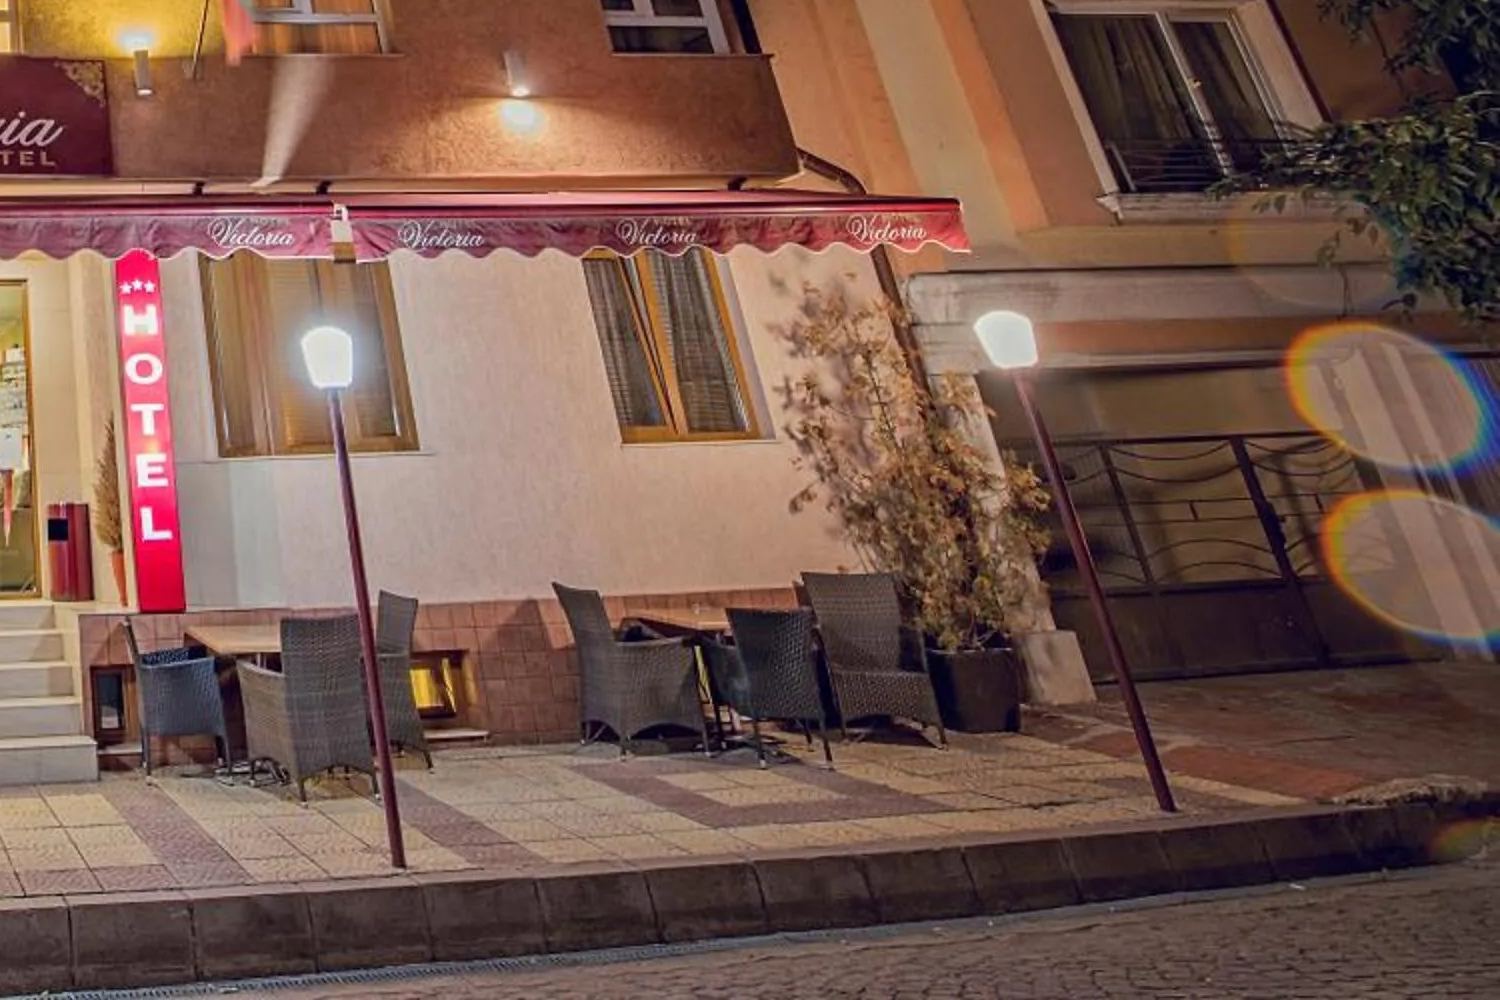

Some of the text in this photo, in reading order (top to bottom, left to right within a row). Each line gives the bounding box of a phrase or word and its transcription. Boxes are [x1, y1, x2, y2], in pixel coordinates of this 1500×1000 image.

[206, 216, 294, 249] Victoria
[398, 219, 484, 253] Victoria
[615, 218, 697, 245] Victoria
[846, 213, 927, 245] Victoria
[122, 303, 173, 542] HOTEL
